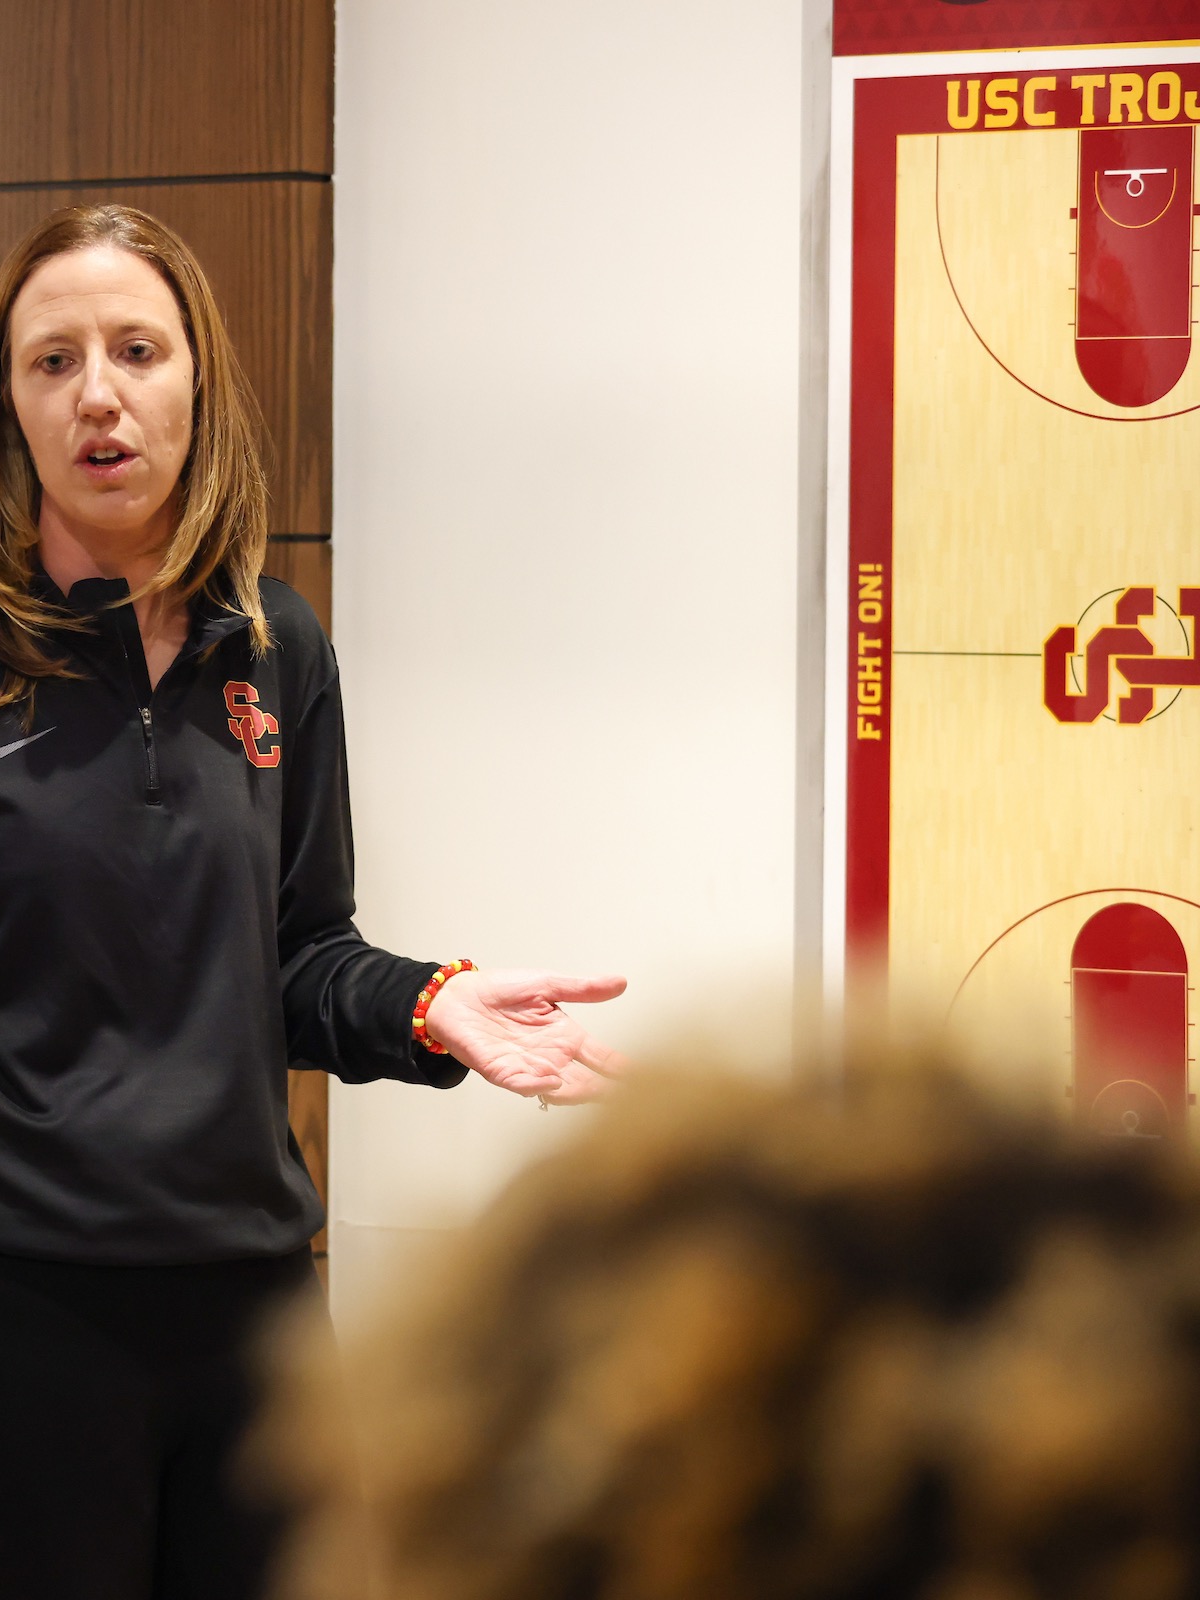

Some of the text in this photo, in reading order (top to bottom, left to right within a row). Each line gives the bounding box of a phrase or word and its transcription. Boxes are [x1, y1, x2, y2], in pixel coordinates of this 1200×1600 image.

[946, 76, 1057, 129] USC
[856, 563, 883, 740] FIGHT ON!
[222, 680, 280, 768] SC
